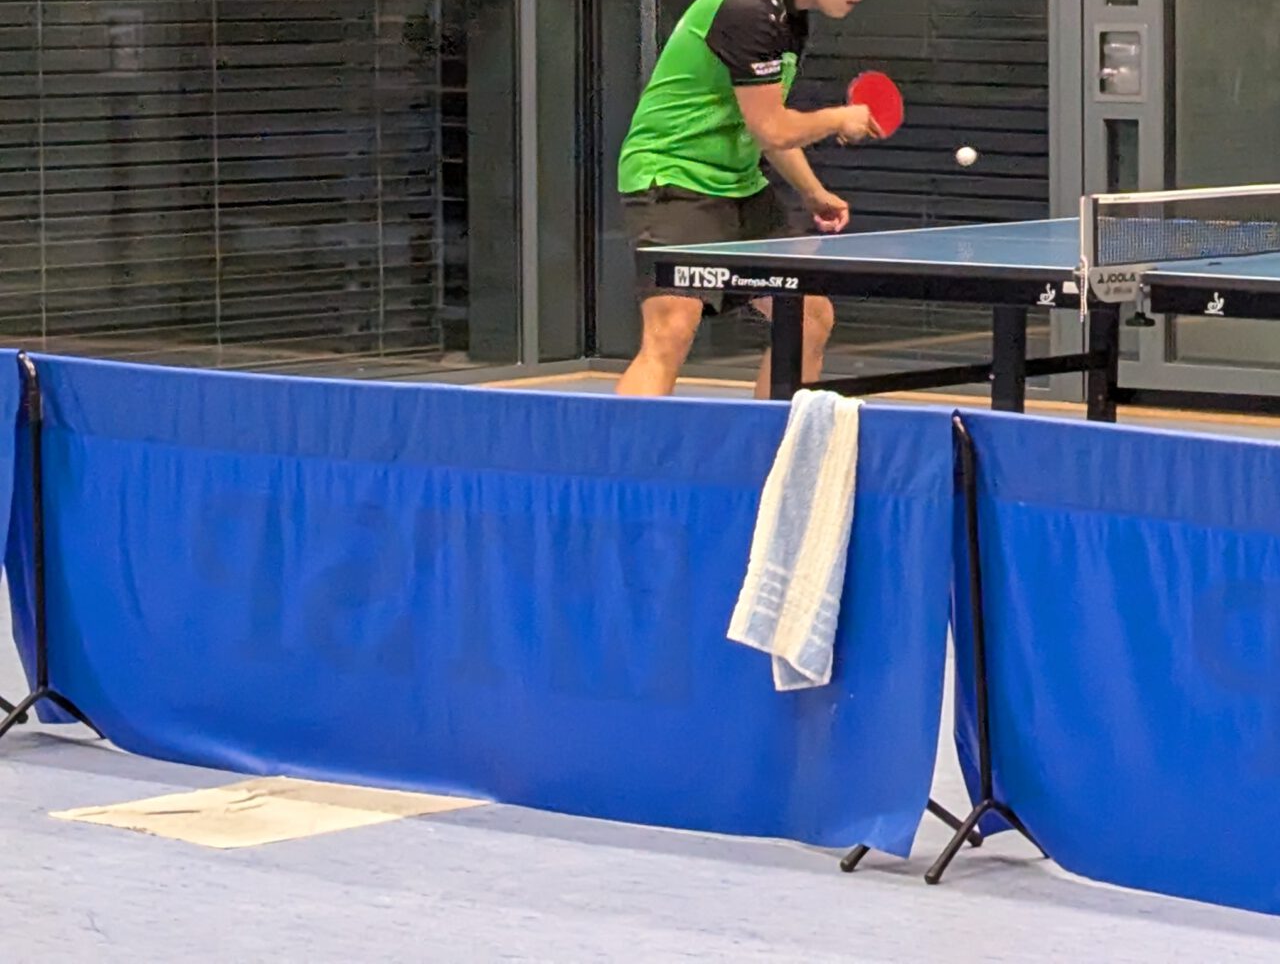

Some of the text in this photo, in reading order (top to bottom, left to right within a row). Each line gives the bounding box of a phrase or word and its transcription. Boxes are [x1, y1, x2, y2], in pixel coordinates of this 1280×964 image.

[691, 267, 730, 288] TSP
[784, 277, 799, 289] 22
[1105, 272, 1136, 284] JOOLA
